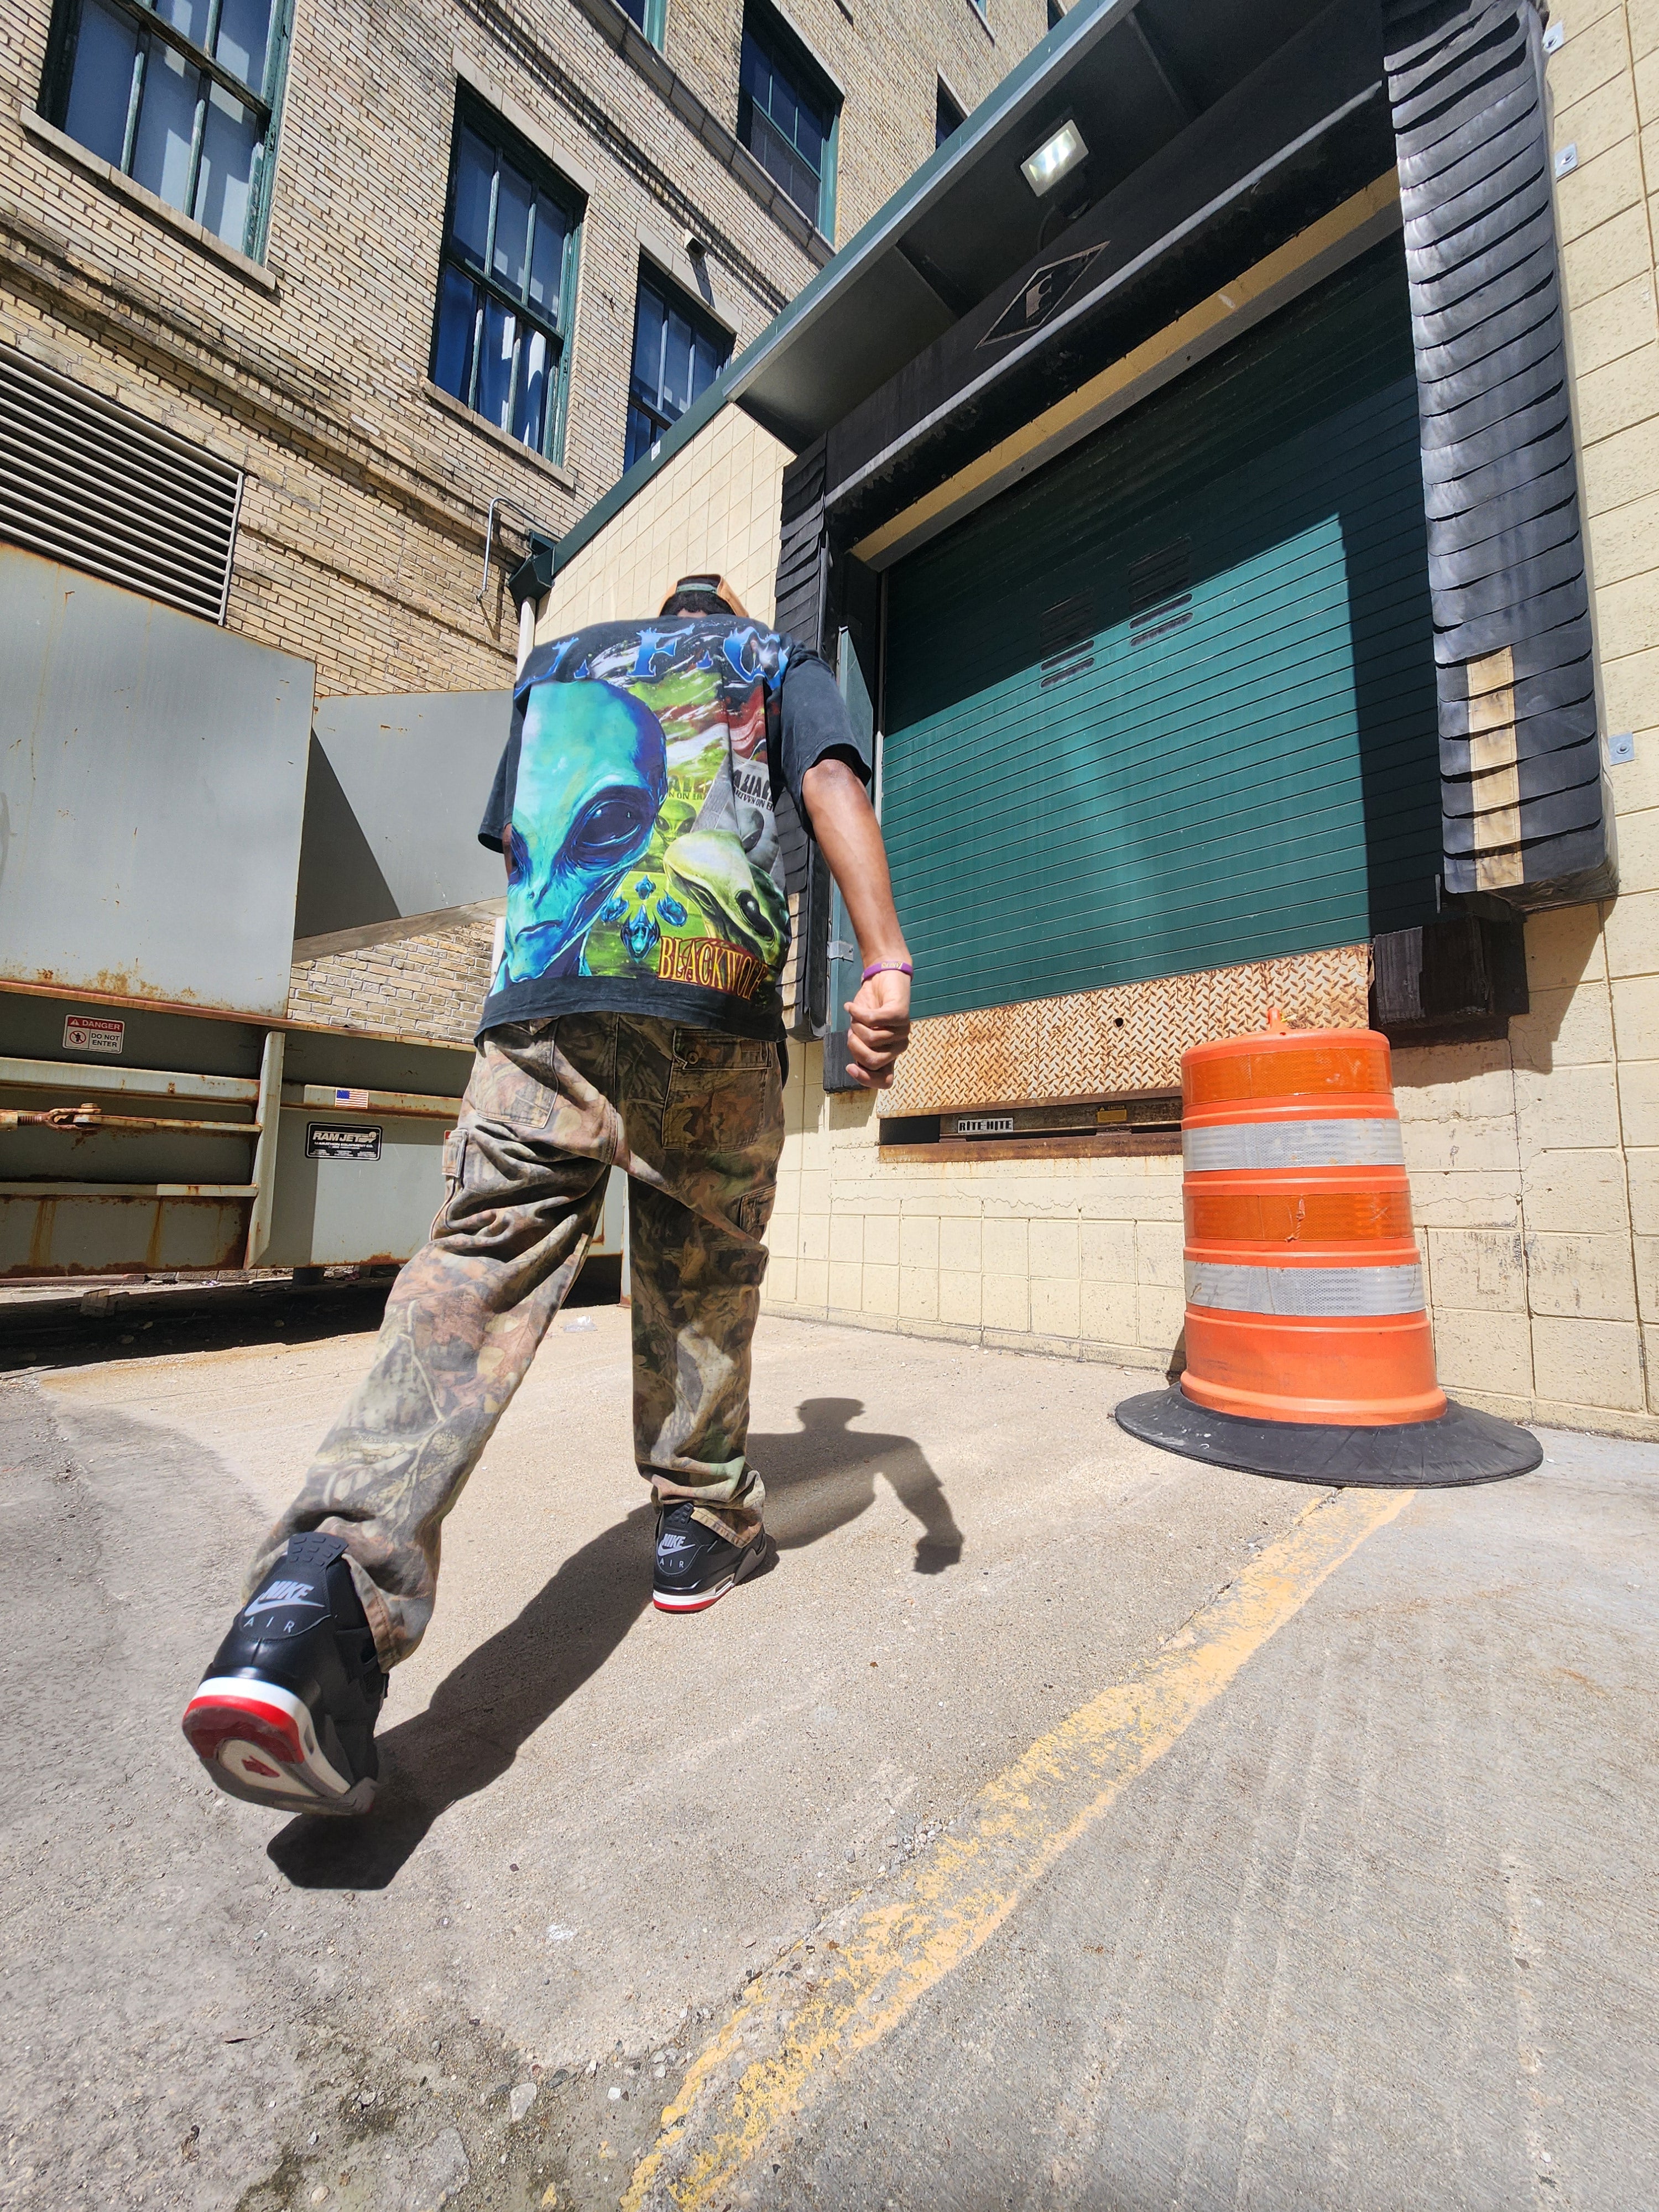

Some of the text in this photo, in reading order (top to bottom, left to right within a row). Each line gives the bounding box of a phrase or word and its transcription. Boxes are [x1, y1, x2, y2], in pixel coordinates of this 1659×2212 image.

[659, 936, 769, 1001] BLACKWOLF
[82, 1019, 121, 1030] DANGER
[959, 1120, 1013, 1131] RITE-HITE
[662, 1533, 686, 1548] NIKE
[659, 1557, 684, 1568] AIR
[259, 1580, 315, 1601] NIKE
[243, 1616, 295, 1634] AIR
